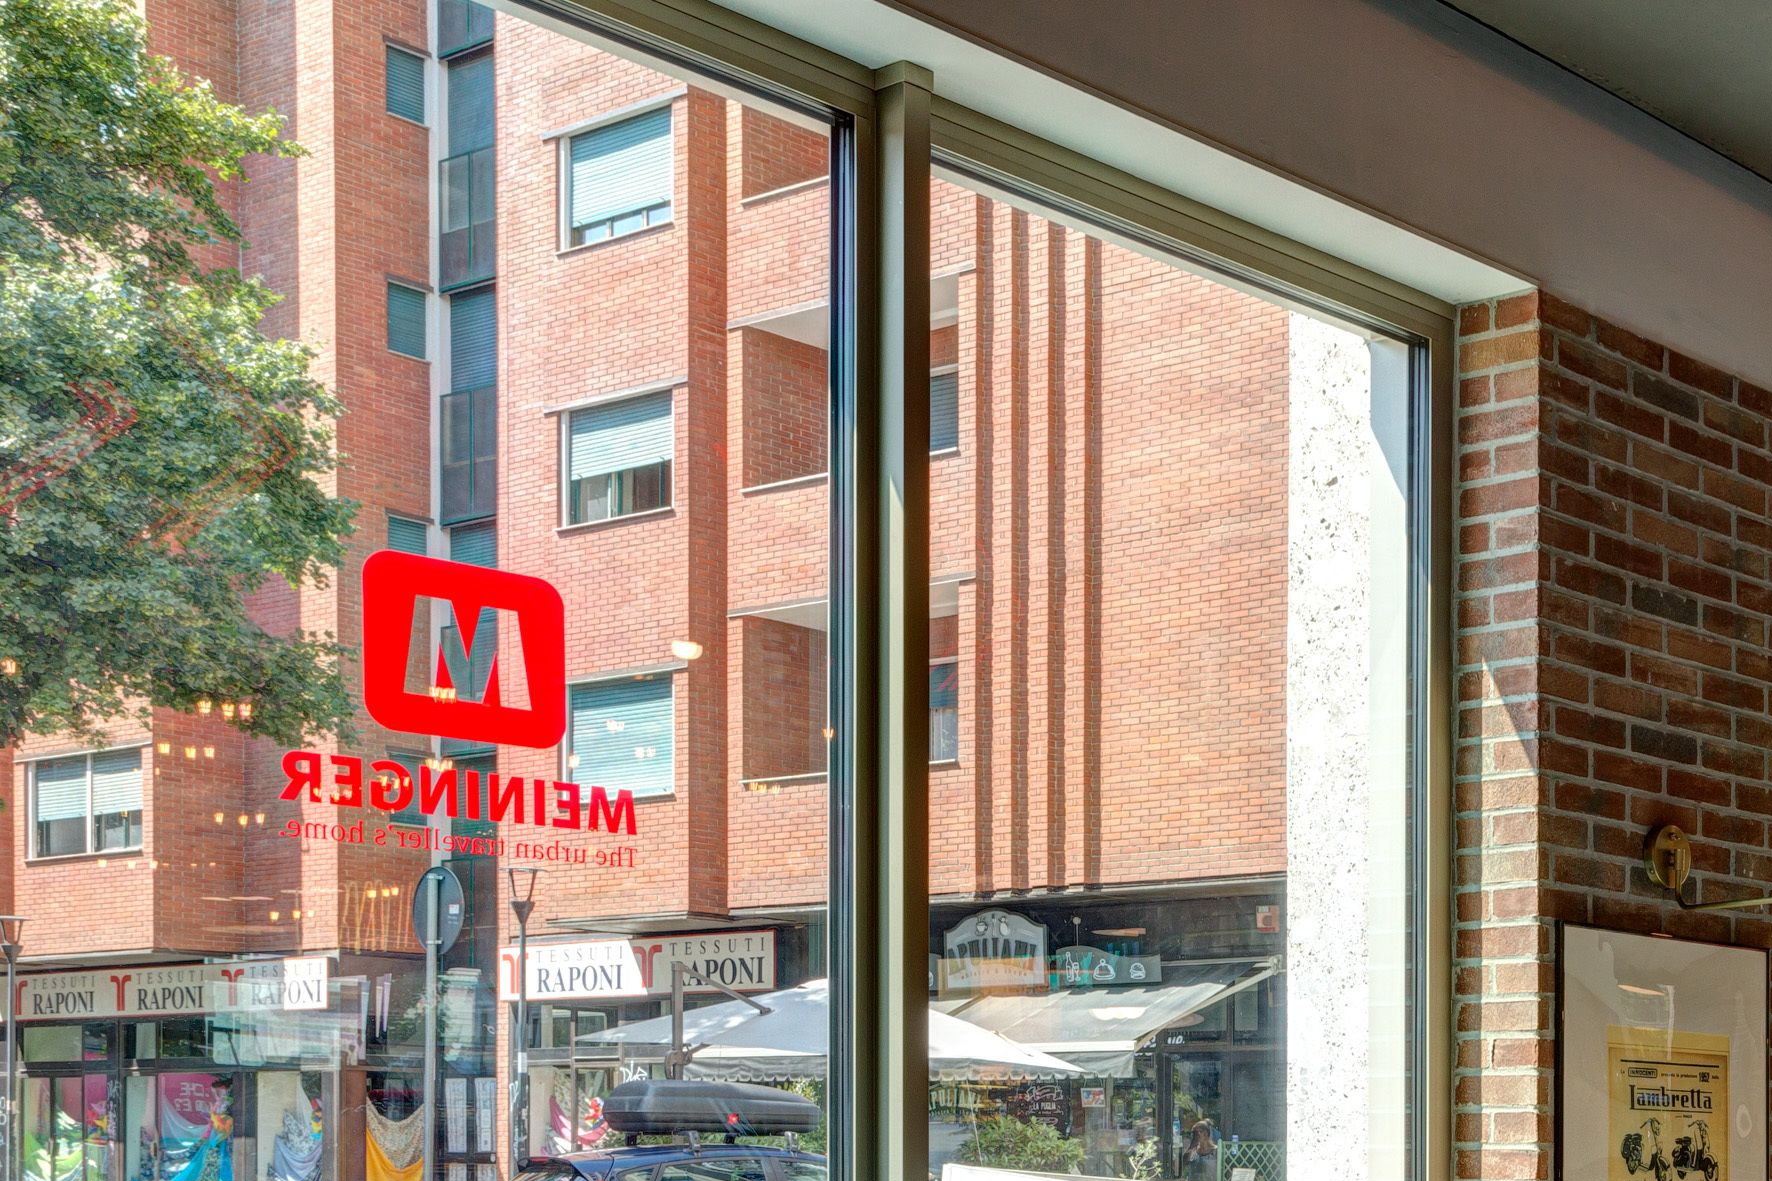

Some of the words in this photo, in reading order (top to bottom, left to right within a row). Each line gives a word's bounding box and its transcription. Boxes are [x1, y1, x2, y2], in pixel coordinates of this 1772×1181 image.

[536, 944, 624, 964] TESSUTI
[670, 936, 765, 957] TESSUTI
[136, 969, 205, 985] TESSUTI
[249, 962, 323, 979] TESSUTI
[536, 964, 623, 993] RAPONI
[32, 975, 96, 990] TESSUTI
[250, 979, 321, 1005] RAPONI
[33, 991, 95, 1015] RAPONI
[137, 985, 204, 1011] RAPONI
[1629, 1084, 1713, 1111] Lambretta
